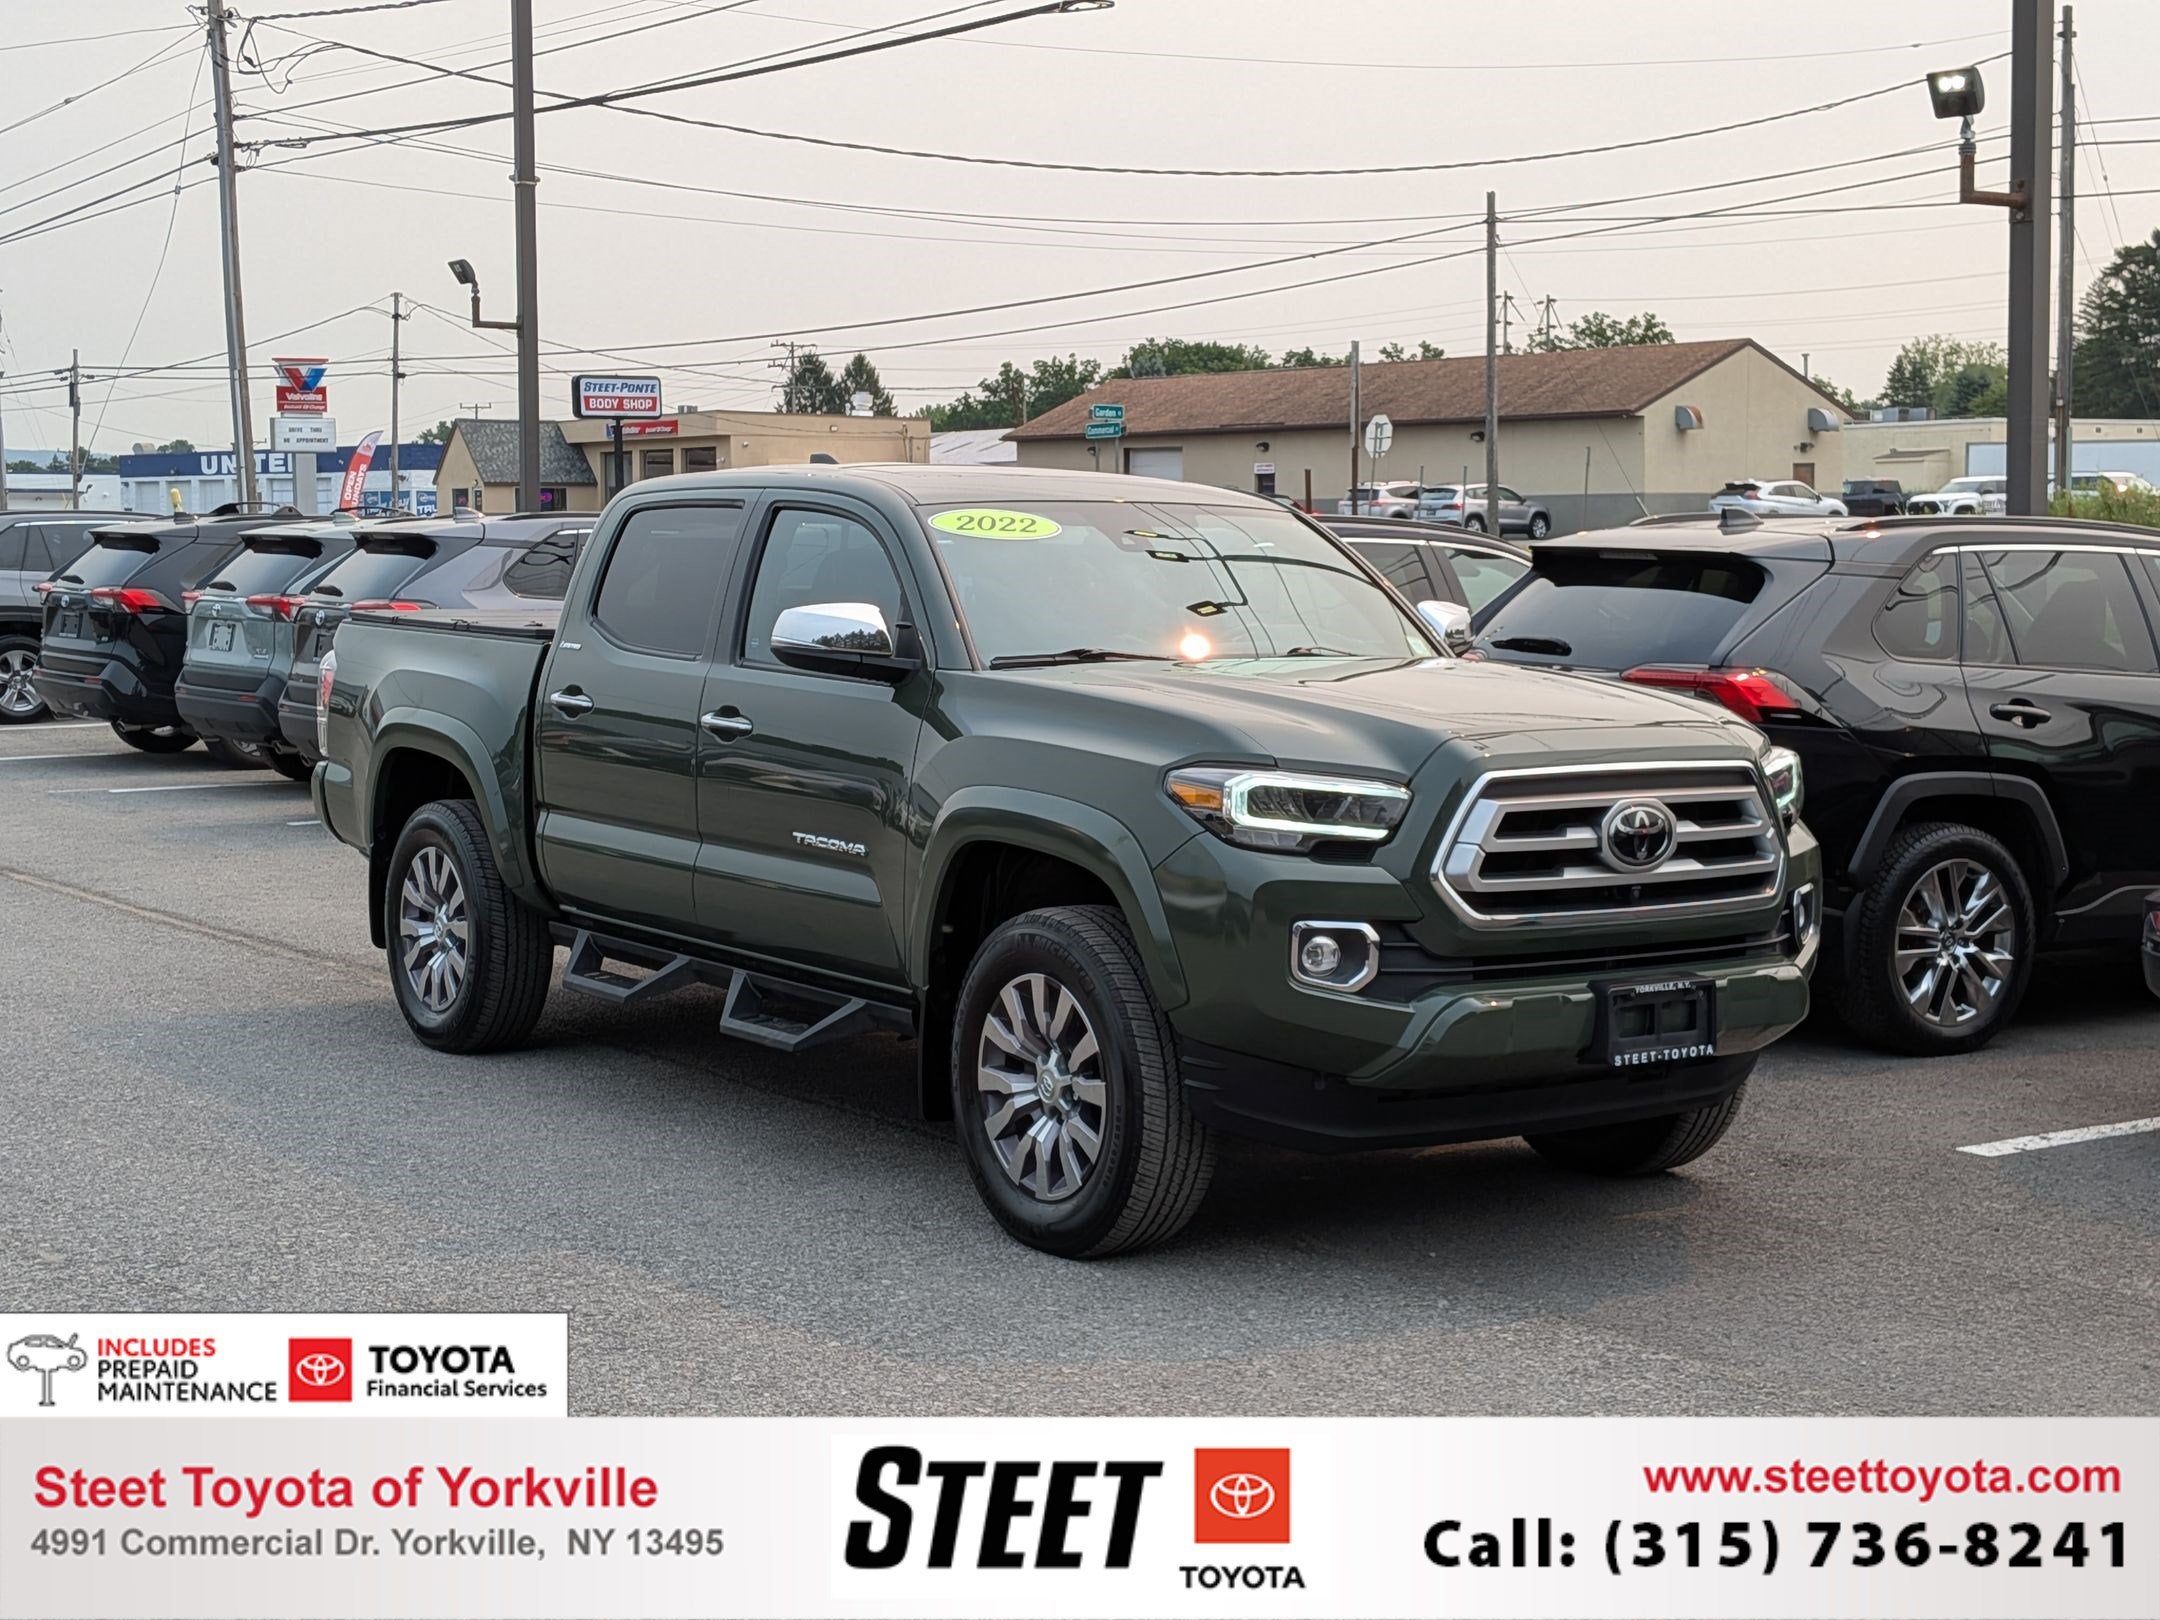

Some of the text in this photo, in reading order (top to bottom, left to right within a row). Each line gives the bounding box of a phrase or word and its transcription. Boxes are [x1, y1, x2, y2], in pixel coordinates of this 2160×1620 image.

[285, 392, 323, 401] Valvoline
[589, 398, 653, 410] BODY SHOP
[200, 453, 292, 475] UNTE
[344, 471, 356, 501] OPEN
[956, 515, 1038, 533] 2022
[792, 831, 866, 857] TACOMA
